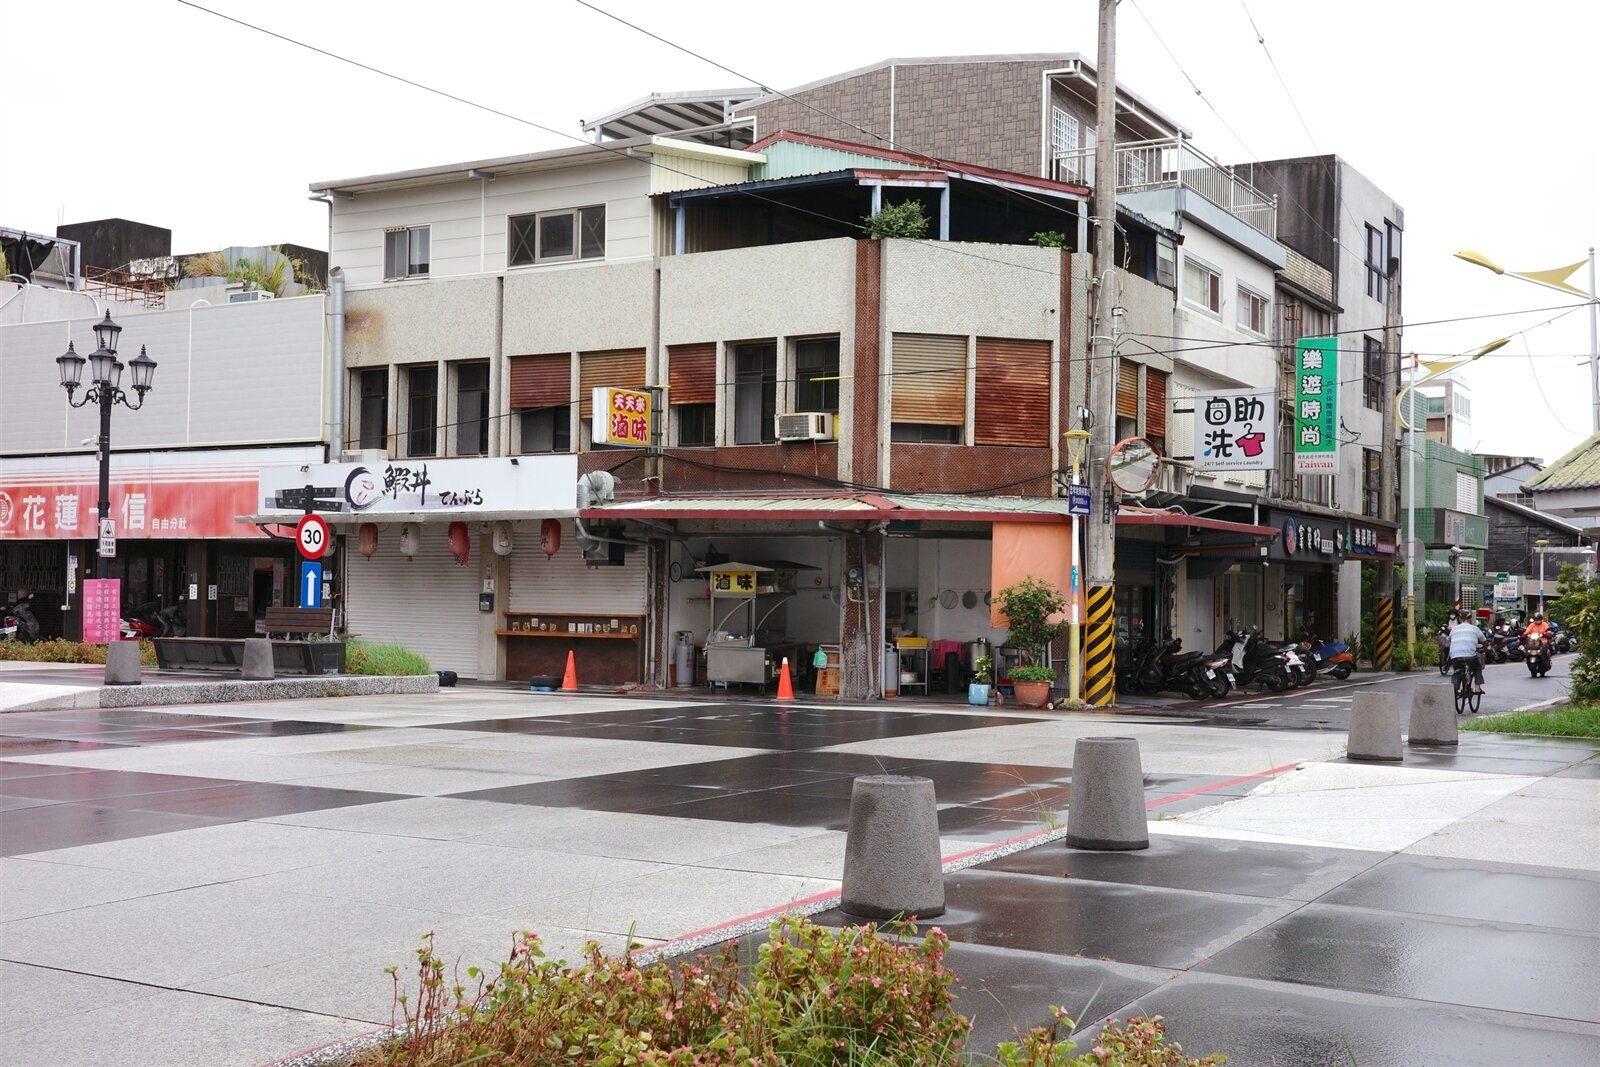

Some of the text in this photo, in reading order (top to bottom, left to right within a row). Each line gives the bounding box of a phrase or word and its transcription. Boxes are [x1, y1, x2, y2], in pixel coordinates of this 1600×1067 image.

[614, 393, 646, 412] 天天來
[1205, 396, 1264, 425] 自助
[1301, 349, 1322, 446] 樂遊時尚
[612, 413, 647, 442] 滷味
[1204, 429, 1233, 458] 洗
[1298, 460, 1334, 469] Taiwan
[23, 493, 187, 531] 花蓮一信 自由分社
[303, 528, 322, 545] 30
[716, 574, 753, 590] 滷味
